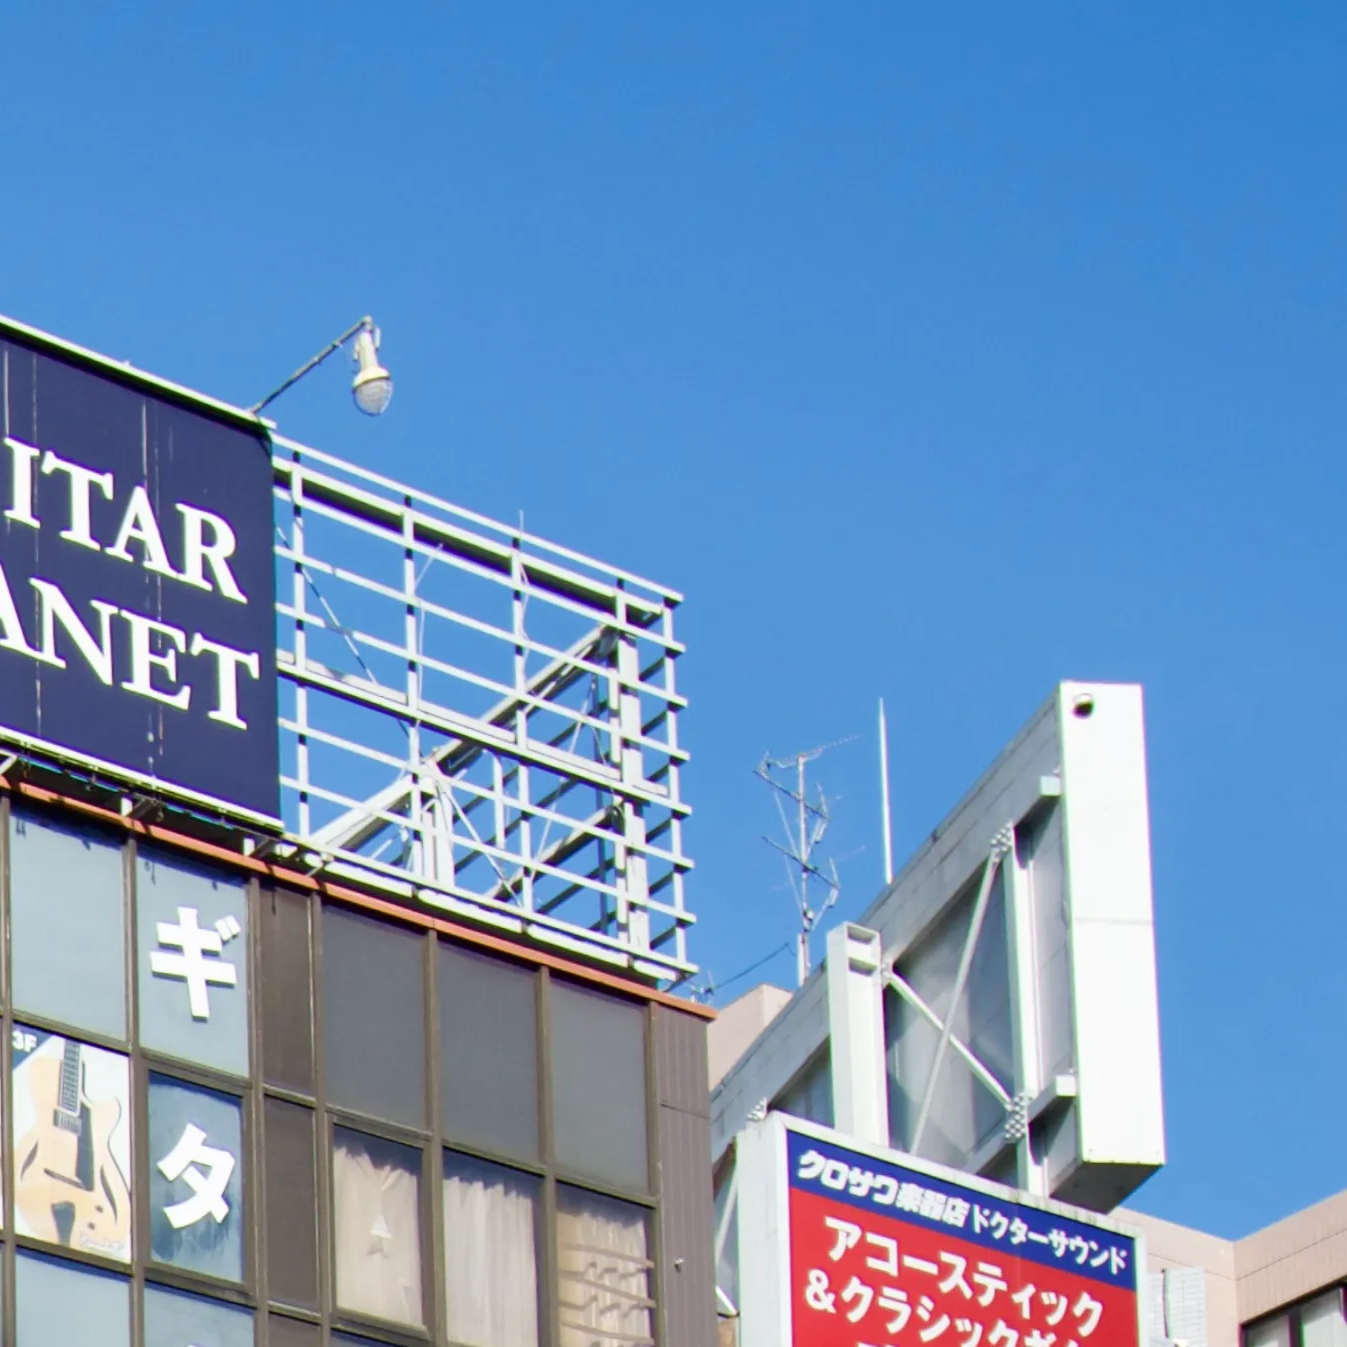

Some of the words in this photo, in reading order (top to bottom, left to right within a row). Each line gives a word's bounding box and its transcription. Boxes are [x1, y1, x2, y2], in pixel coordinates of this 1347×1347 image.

[12, 1029, 37, 1053] 3F
[797, 1150, 968, 1225] クロサワ楽器店
[972, 1209, 1127, 1274] ドクターサウンド
[824, 1216, 1104, 1334] アコースティック
